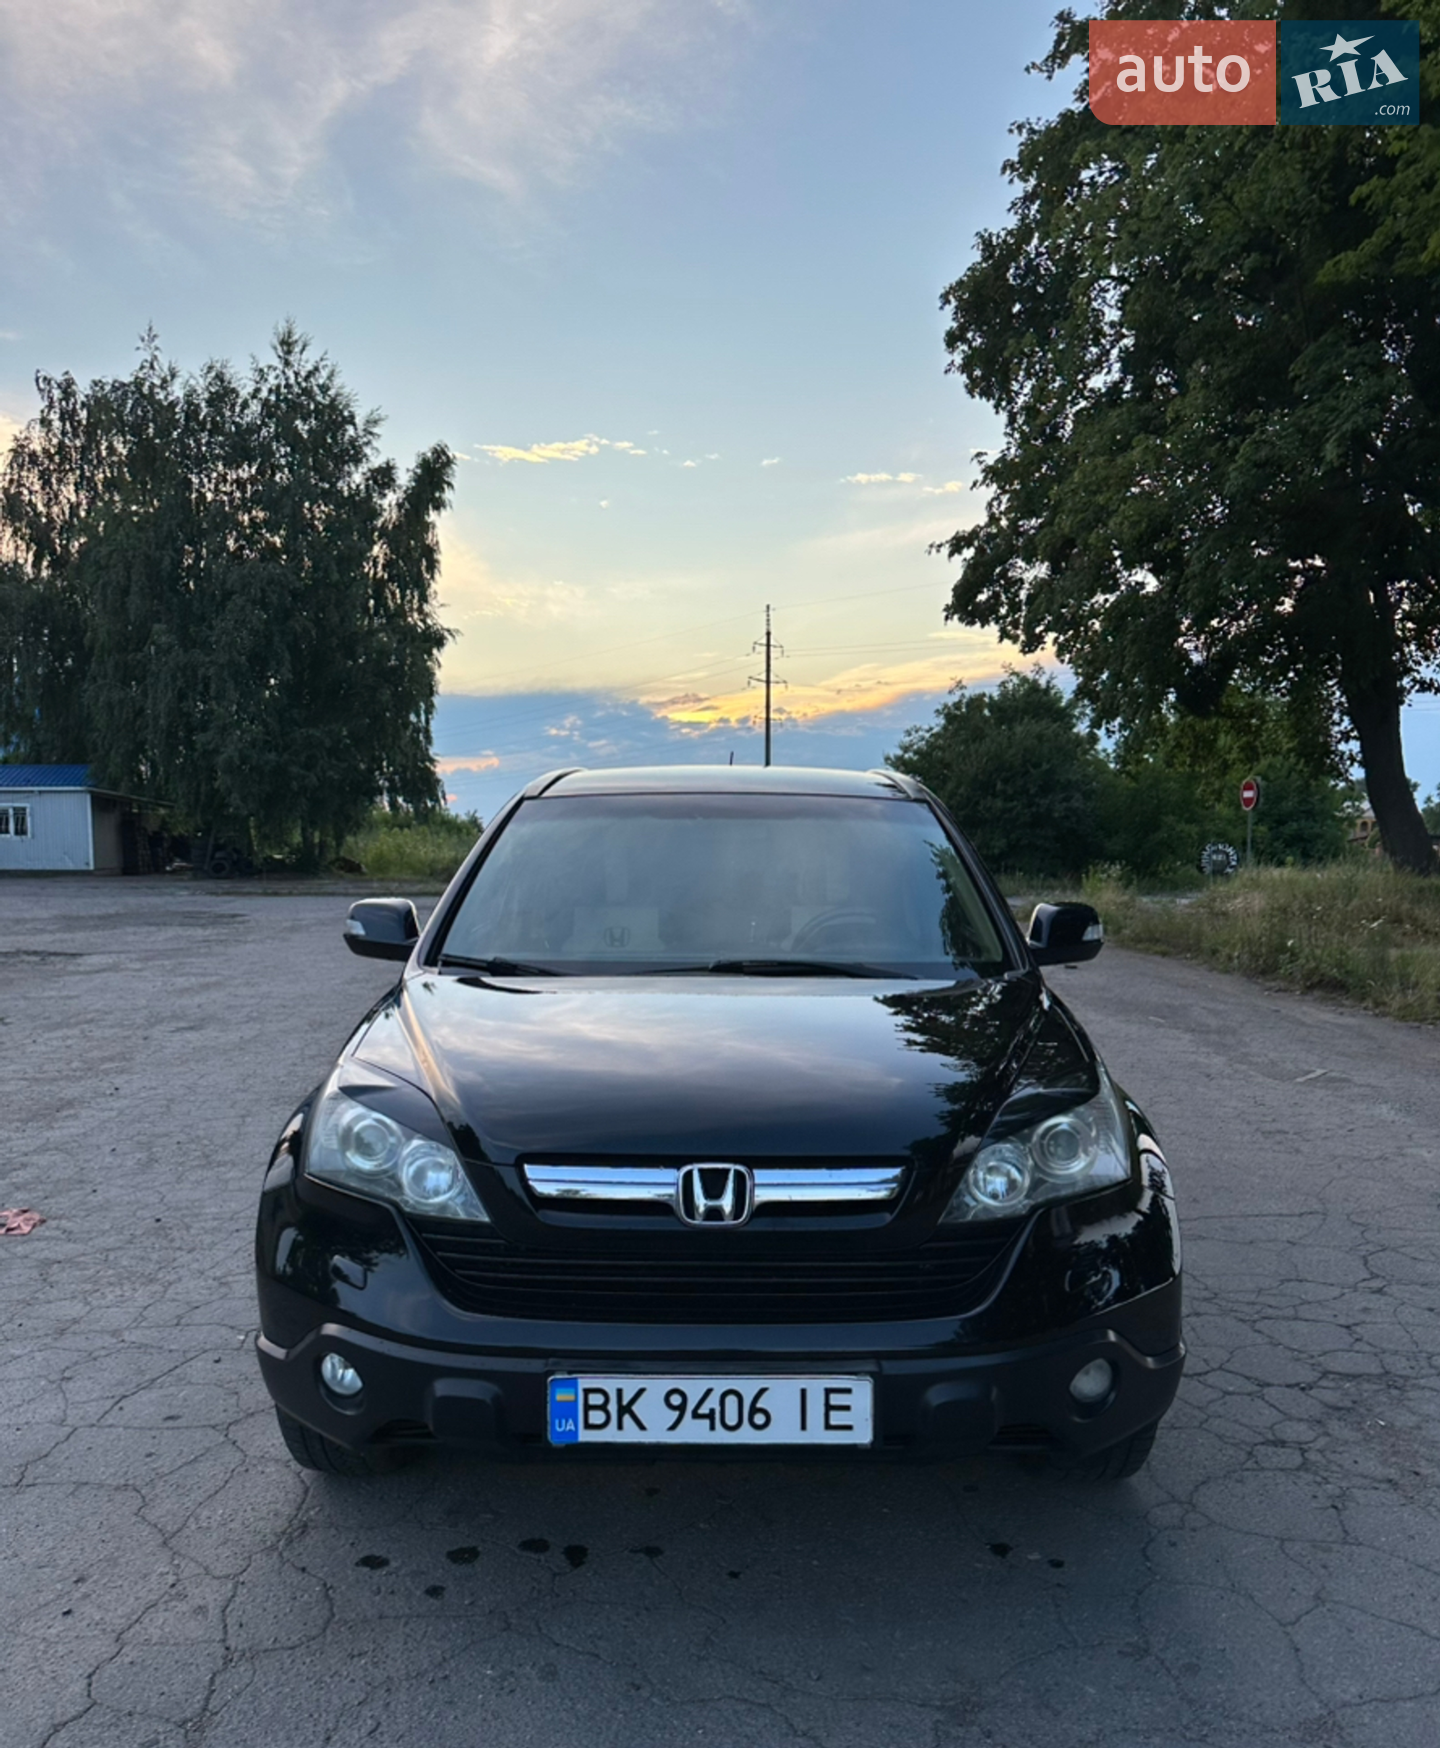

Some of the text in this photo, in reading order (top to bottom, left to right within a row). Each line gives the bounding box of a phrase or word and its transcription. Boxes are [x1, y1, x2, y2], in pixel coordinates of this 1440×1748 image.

[582, 1387, 854, 1432] BK 9406 IE
[555, 1418, 576, 1433] UA
